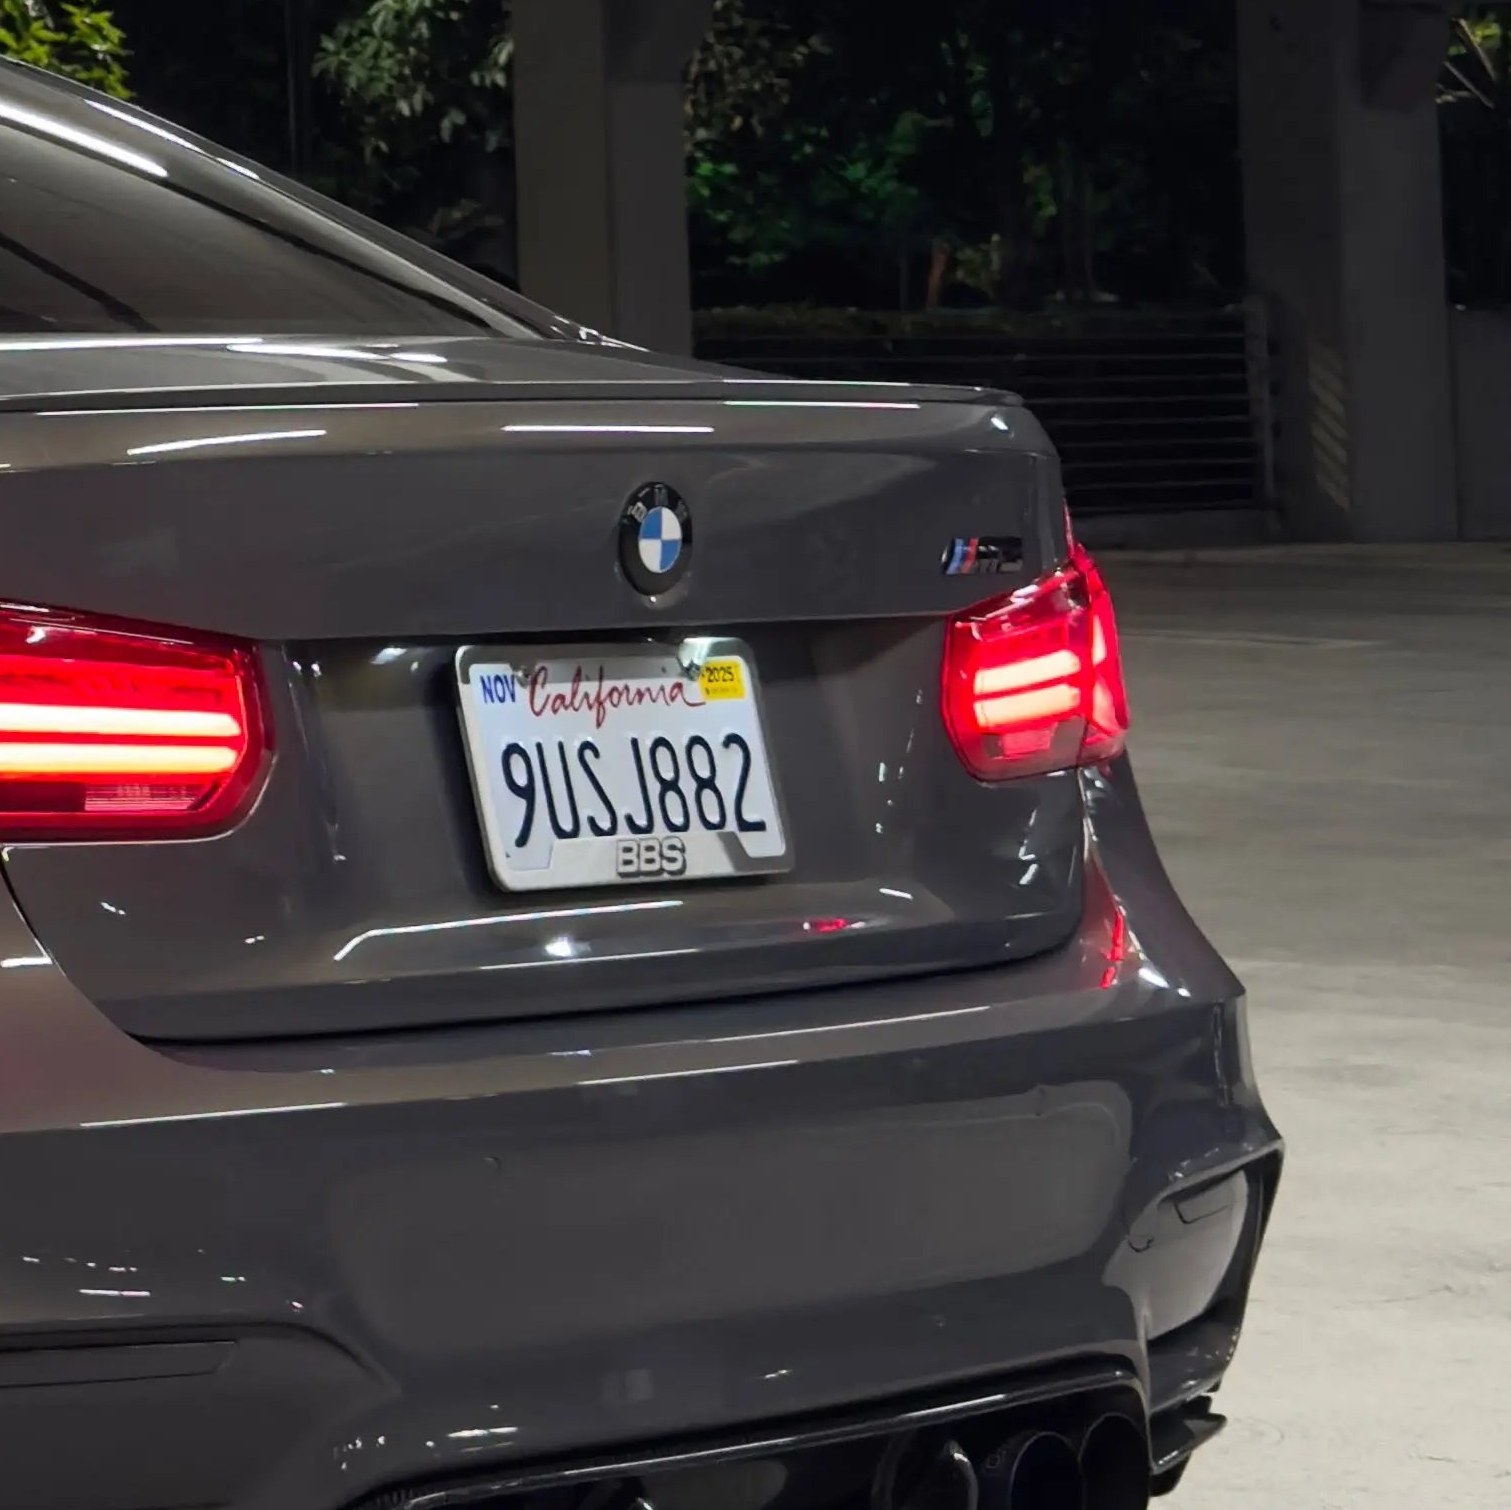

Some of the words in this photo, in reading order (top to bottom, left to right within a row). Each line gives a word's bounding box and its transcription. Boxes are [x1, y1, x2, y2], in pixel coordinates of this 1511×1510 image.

[480, 674, 516, 704] NOV
[706, 666, 734, 682] 2025
[529, 665, 706, 728] California
[501, 733, 766, 848] 9USJ882
[617, 836, 687, 878] BBS
